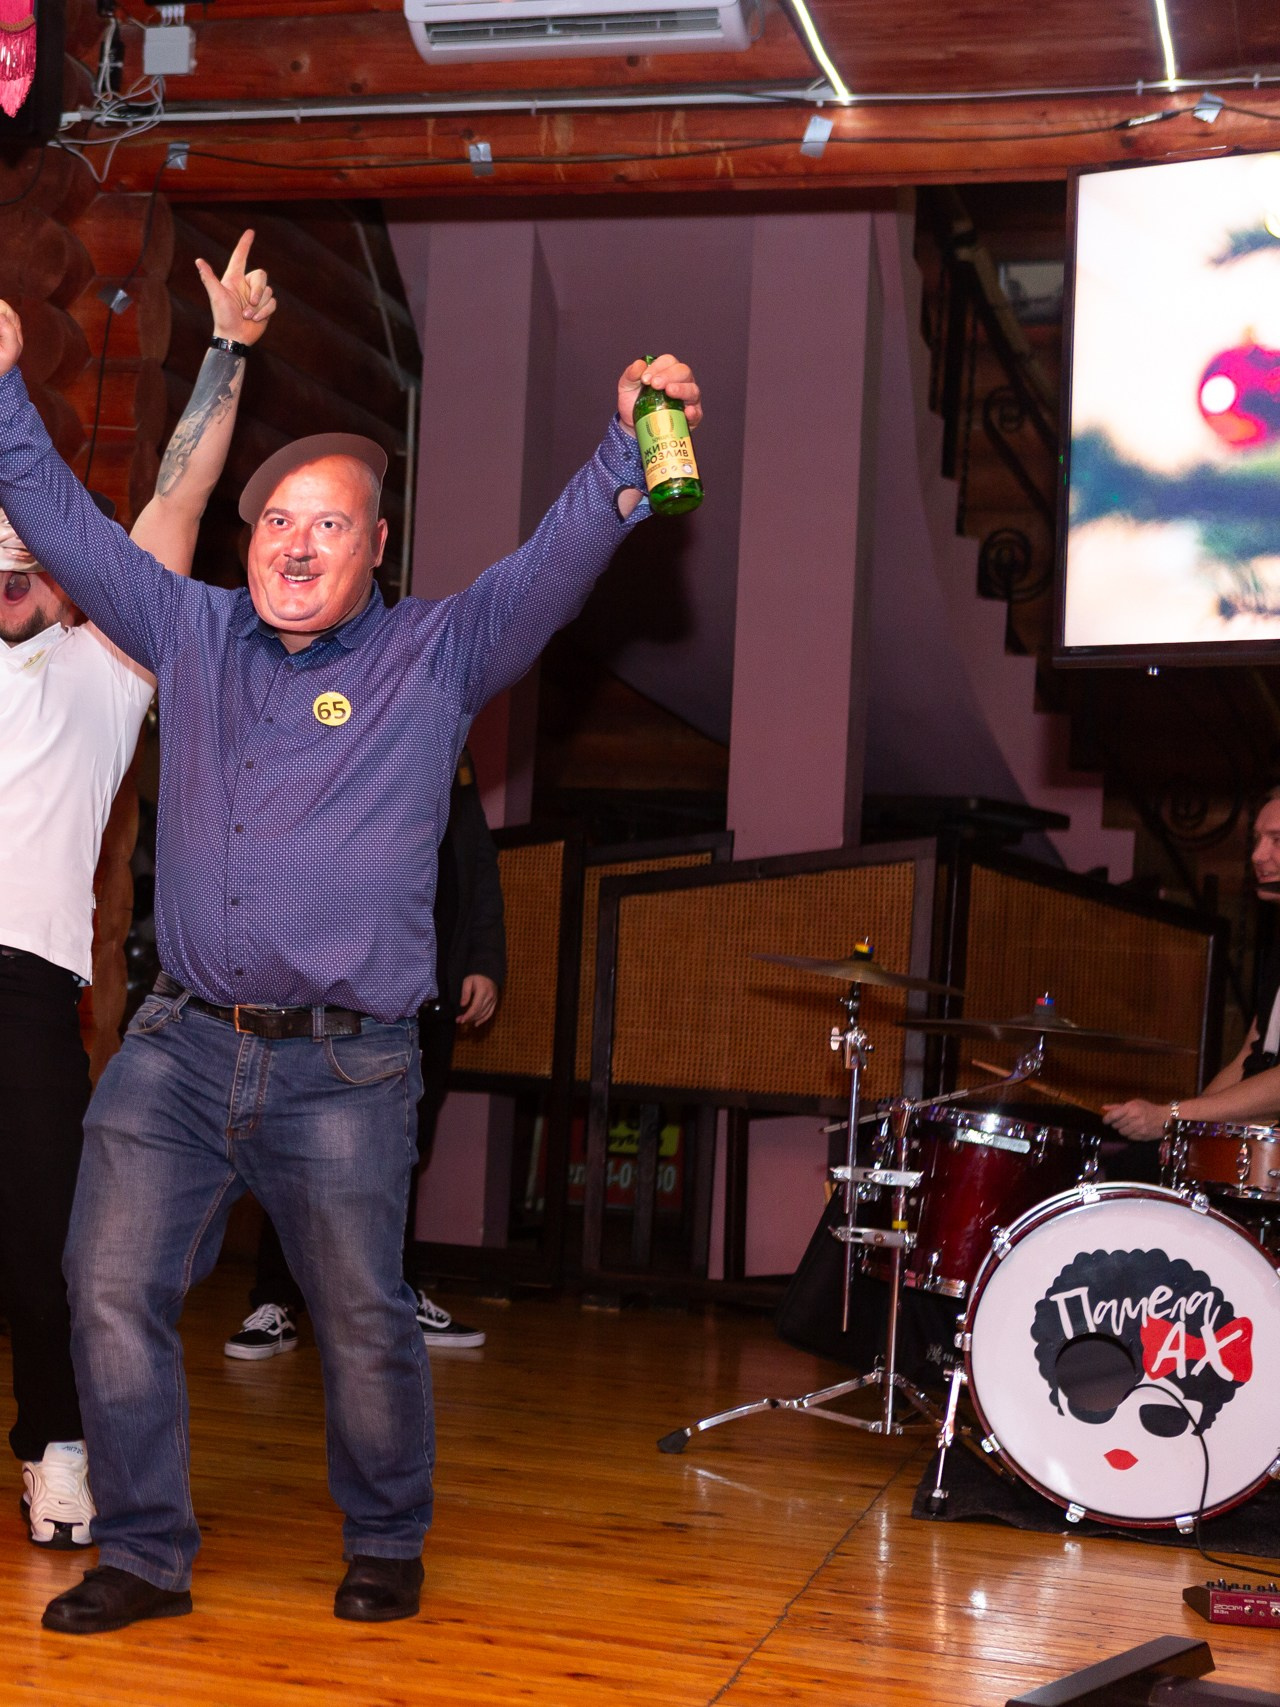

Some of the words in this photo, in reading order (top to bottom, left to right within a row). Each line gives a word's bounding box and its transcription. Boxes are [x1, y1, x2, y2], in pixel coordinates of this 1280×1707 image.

[644, 437, 687, 457] ЖИВОЙ
[645, 449, 689, 466] РОЗЛИВ
[317, 701, 347, 720] 65
[1151, 1321, 1244, 1382] АХ
